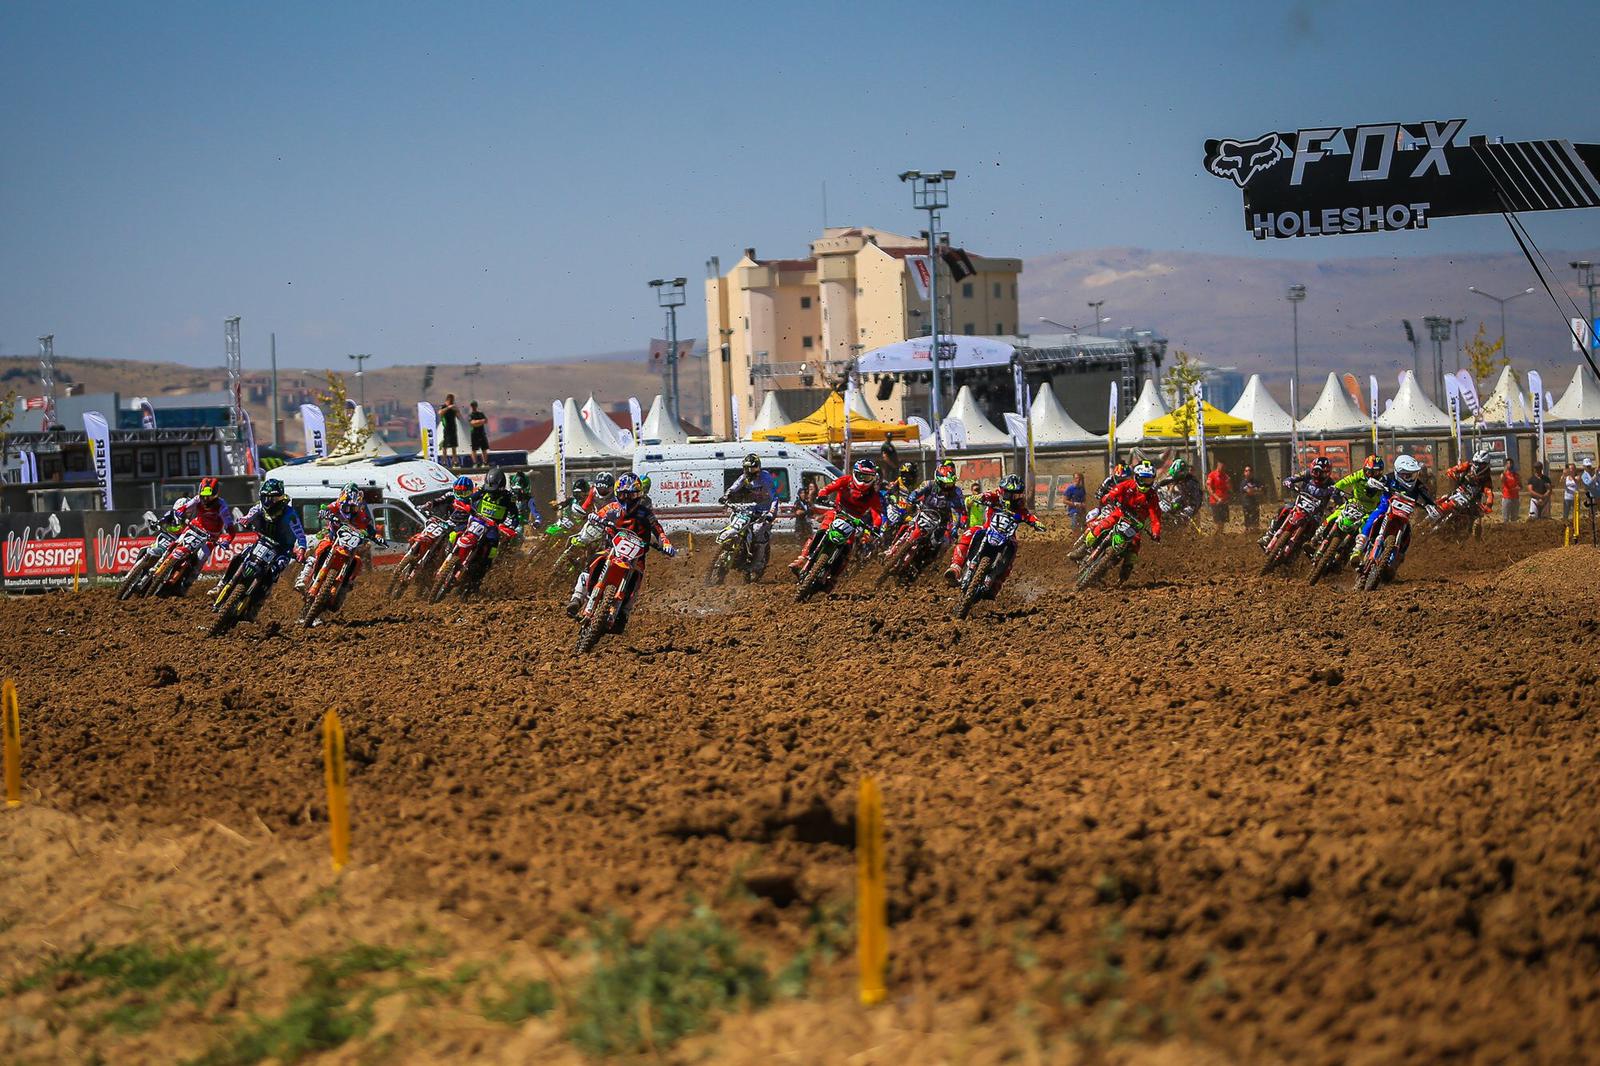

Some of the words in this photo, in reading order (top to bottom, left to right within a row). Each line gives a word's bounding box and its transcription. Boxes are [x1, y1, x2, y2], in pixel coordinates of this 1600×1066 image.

[1290, 120, 1464, 186] FOX
[1253, 202, 1430, 238] HOLESHOT
[676, 489, 701, 504] 112
[6, 526, 83, 573] Wössner
[615, 539, 641, 559] 61
[4, 578, 41, 586] Manufacturer
